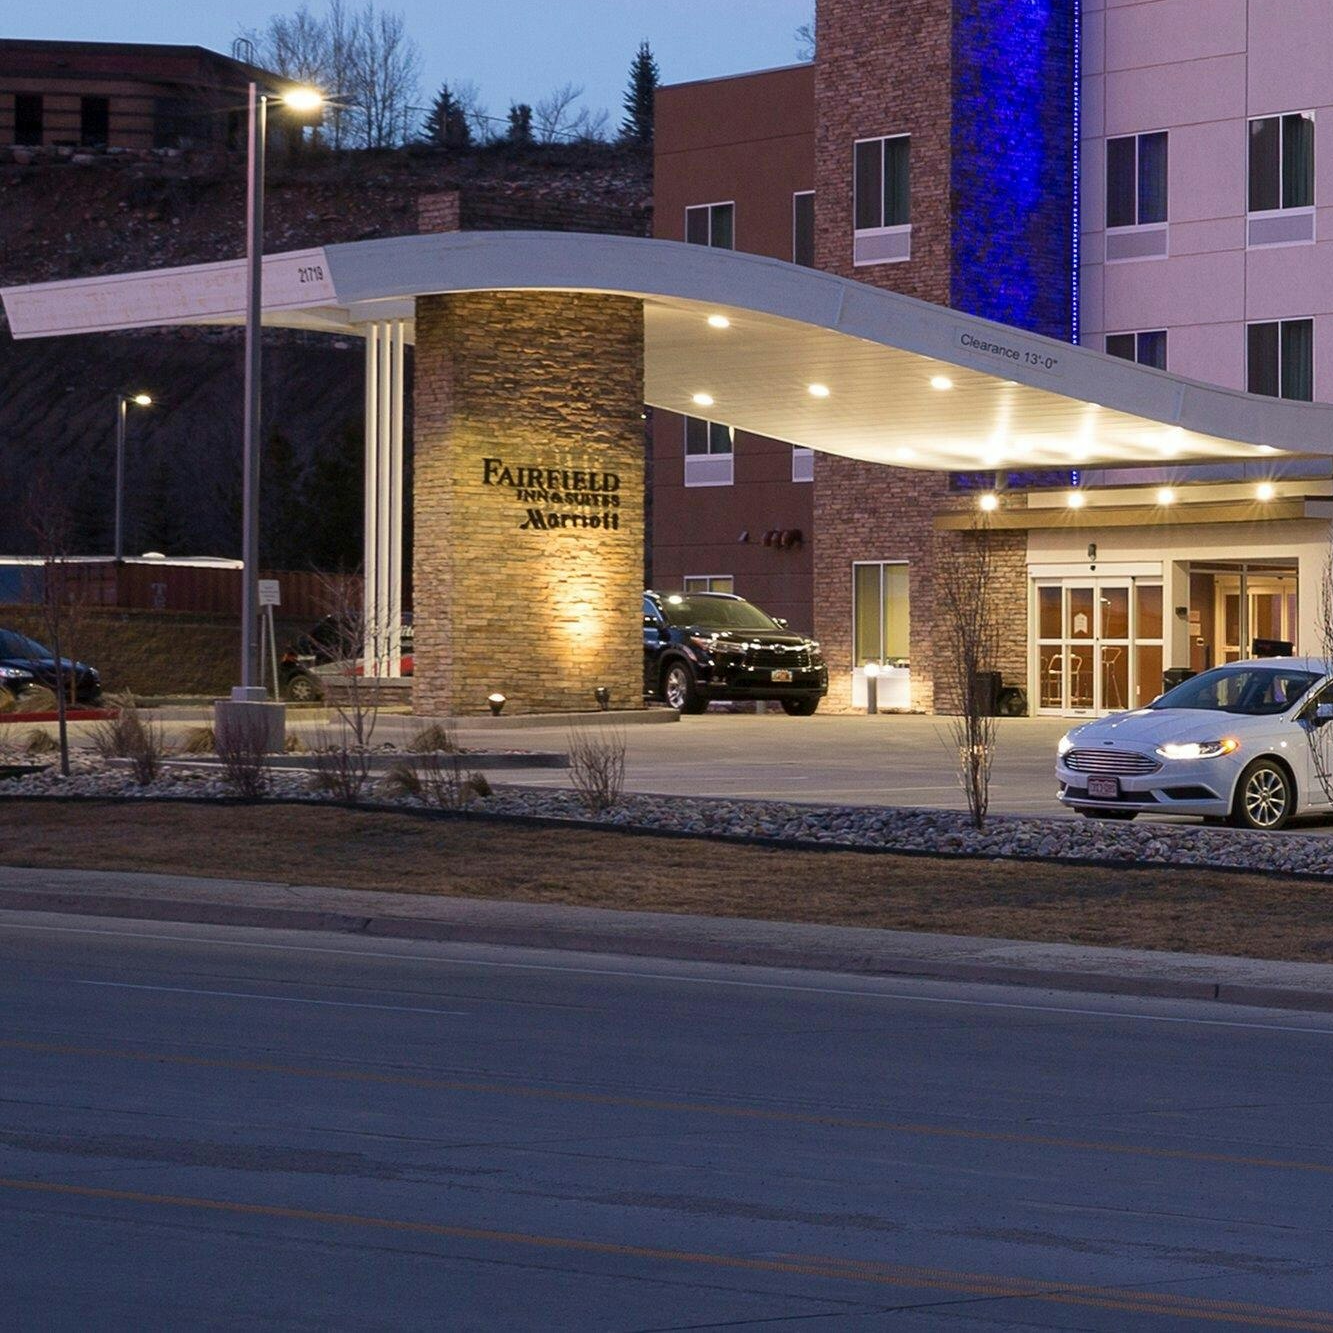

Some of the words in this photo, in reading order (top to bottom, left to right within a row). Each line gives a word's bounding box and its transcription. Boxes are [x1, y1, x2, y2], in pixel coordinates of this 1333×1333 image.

[960, 333, 1021, 360] Clearance
[1024, 352, 1058, 369] 13'-0"
[482, 458, 621, 493] FAIRFIELD
[517, 489, 550, 504] INN
[564, 493, 621, 507] SUITES
[519, 508, 619, 531] Marriott
